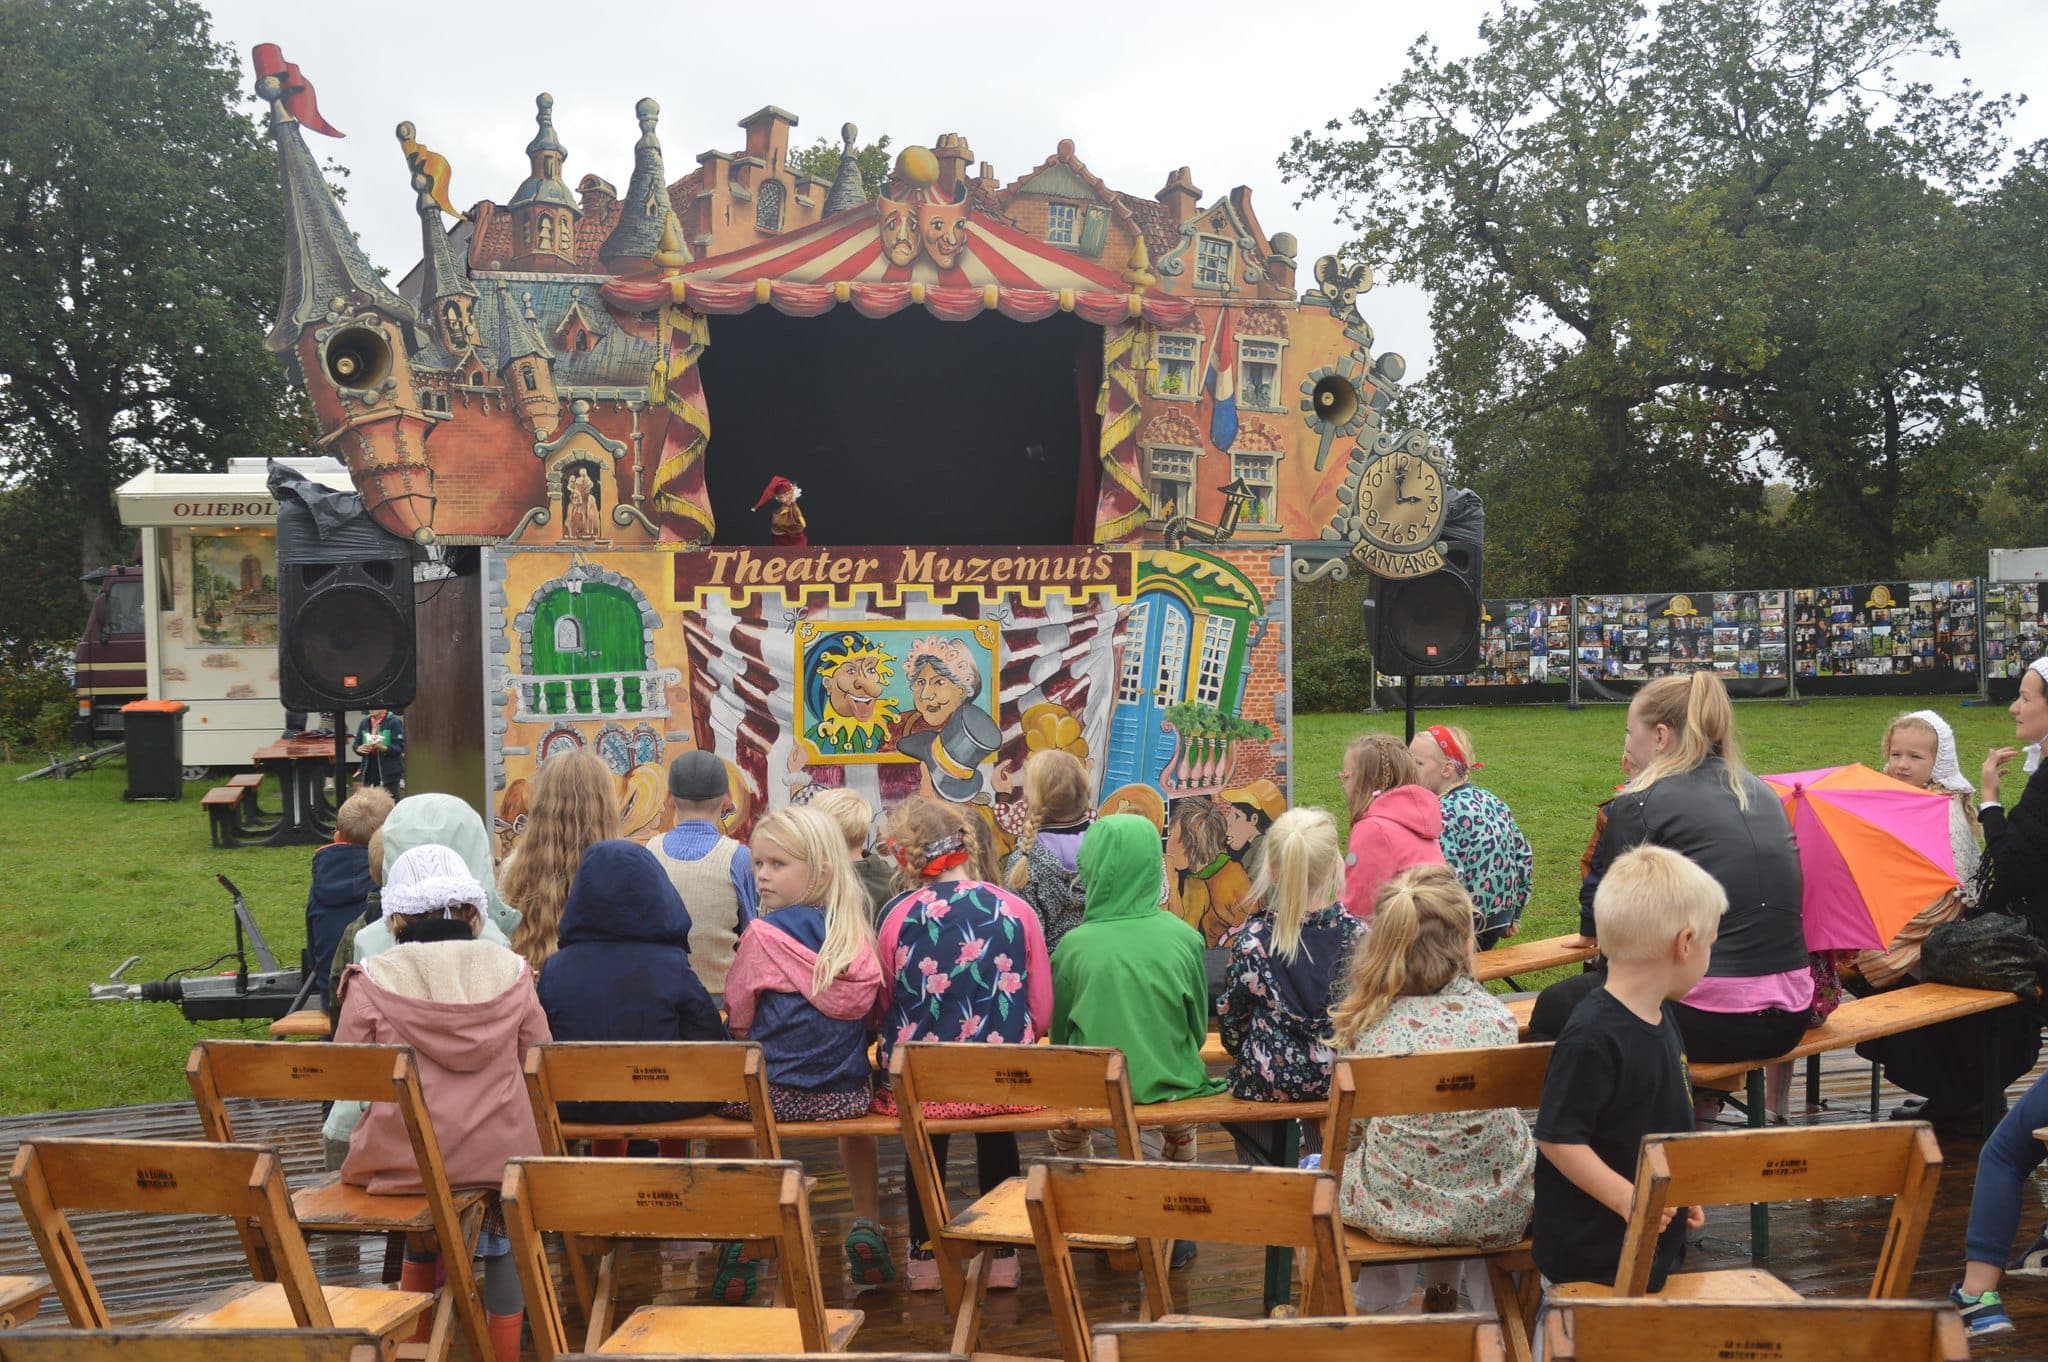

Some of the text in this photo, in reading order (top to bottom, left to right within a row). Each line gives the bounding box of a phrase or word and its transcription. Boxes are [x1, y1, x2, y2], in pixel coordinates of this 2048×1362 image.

[1378, 456, 1390, 473] 11
[1394, 452, 1409, 471] 12
[1417, 460, 1424, 479] 1
[1365, 470, 1382, 488] 10
[1425, 475, 1435, 491] 2
[1362, 491, 1373, 510] 9
[1428, 495, 1439, 512] 3
[1366, 510, 1378, 526] 8
[1421, 517, 1431, 533] 4
[1379, 521, 1391, 539] 7
[1393, 525, 1404, 543] 6
[1408, 524, 1418, 541] 5
[708, 548, 1113, 584] Theater Muzemuis
[1357, 544, 1438, 574] AANVANG
